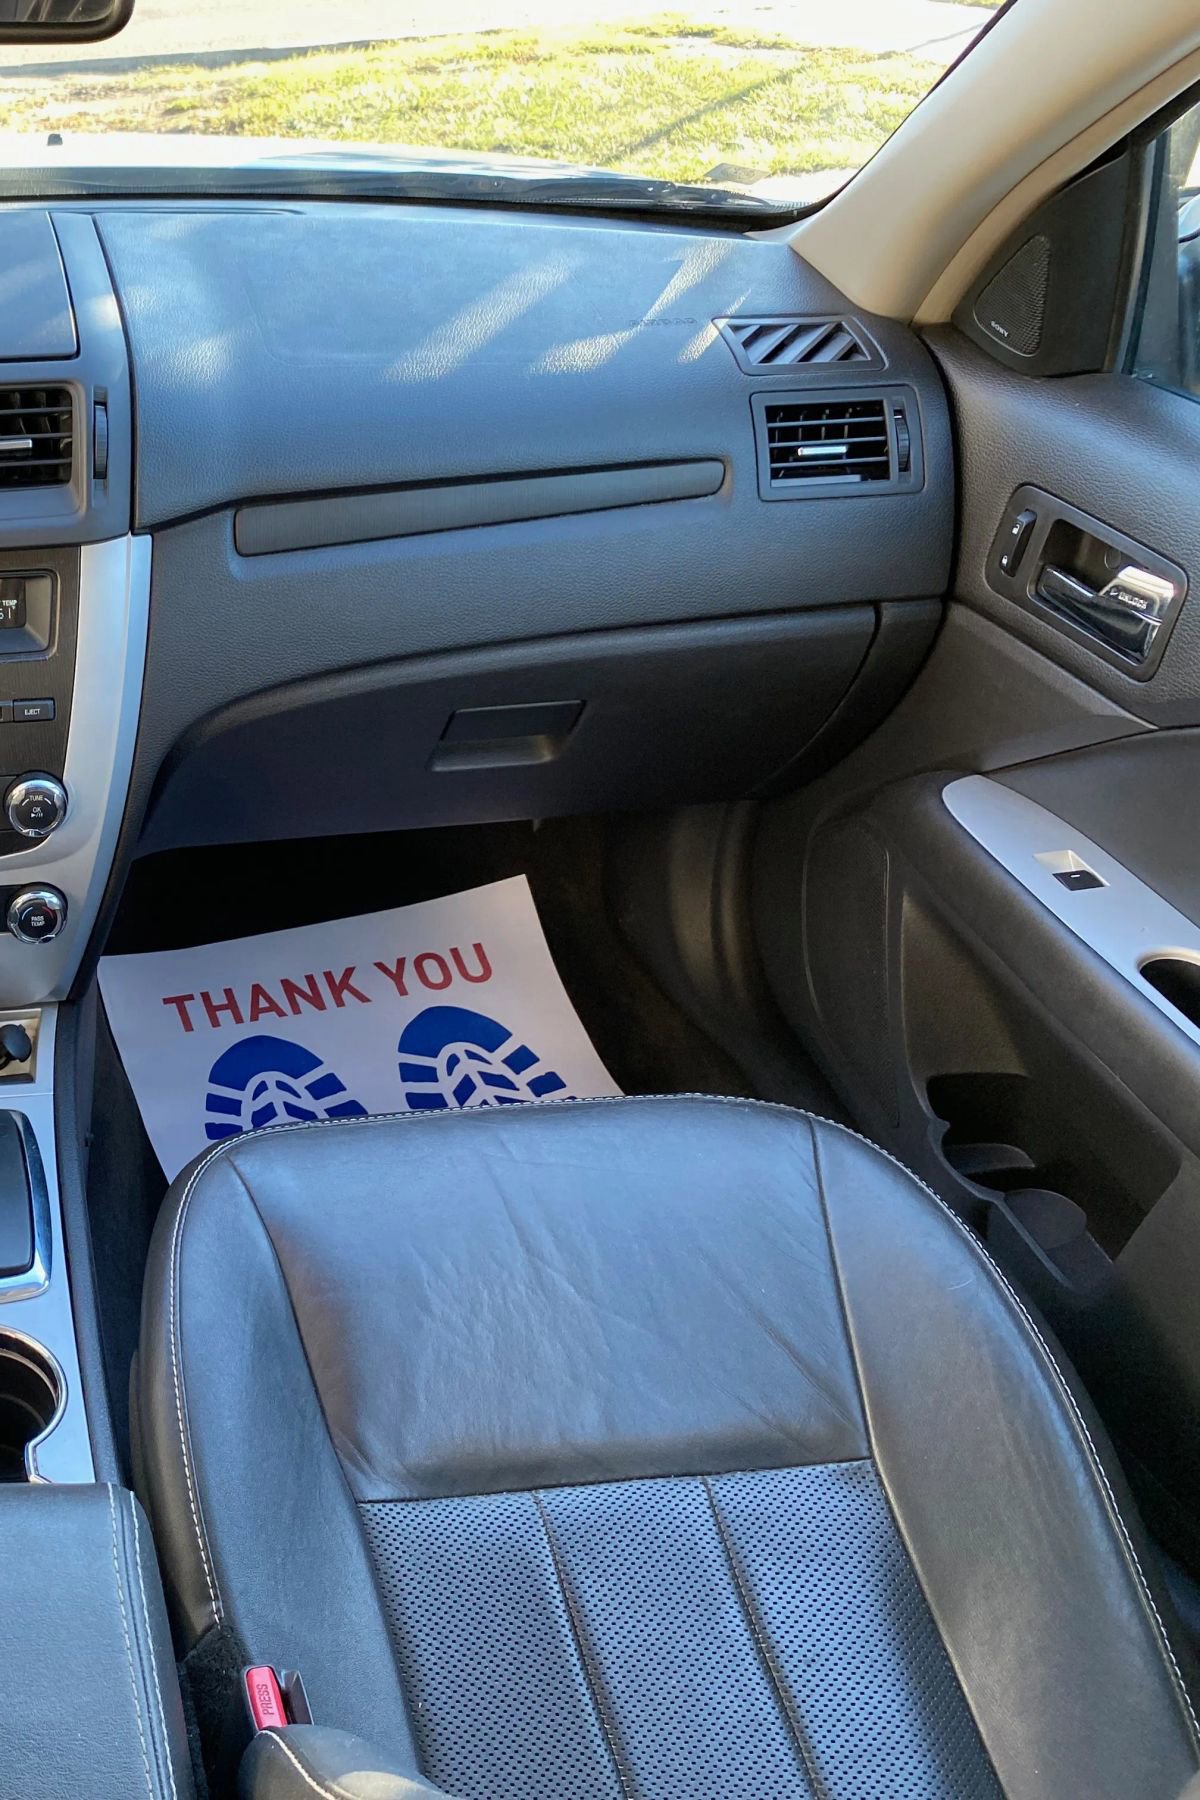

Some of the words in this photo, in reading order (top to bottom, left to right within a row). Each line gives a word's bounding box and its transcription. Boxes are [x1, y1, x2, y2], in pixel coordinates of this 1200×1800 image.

[162, 966, 372, 1032] THANK
[373, 942, 492, 997] YOU
[256, 1684, 274, 1716] PRESS
